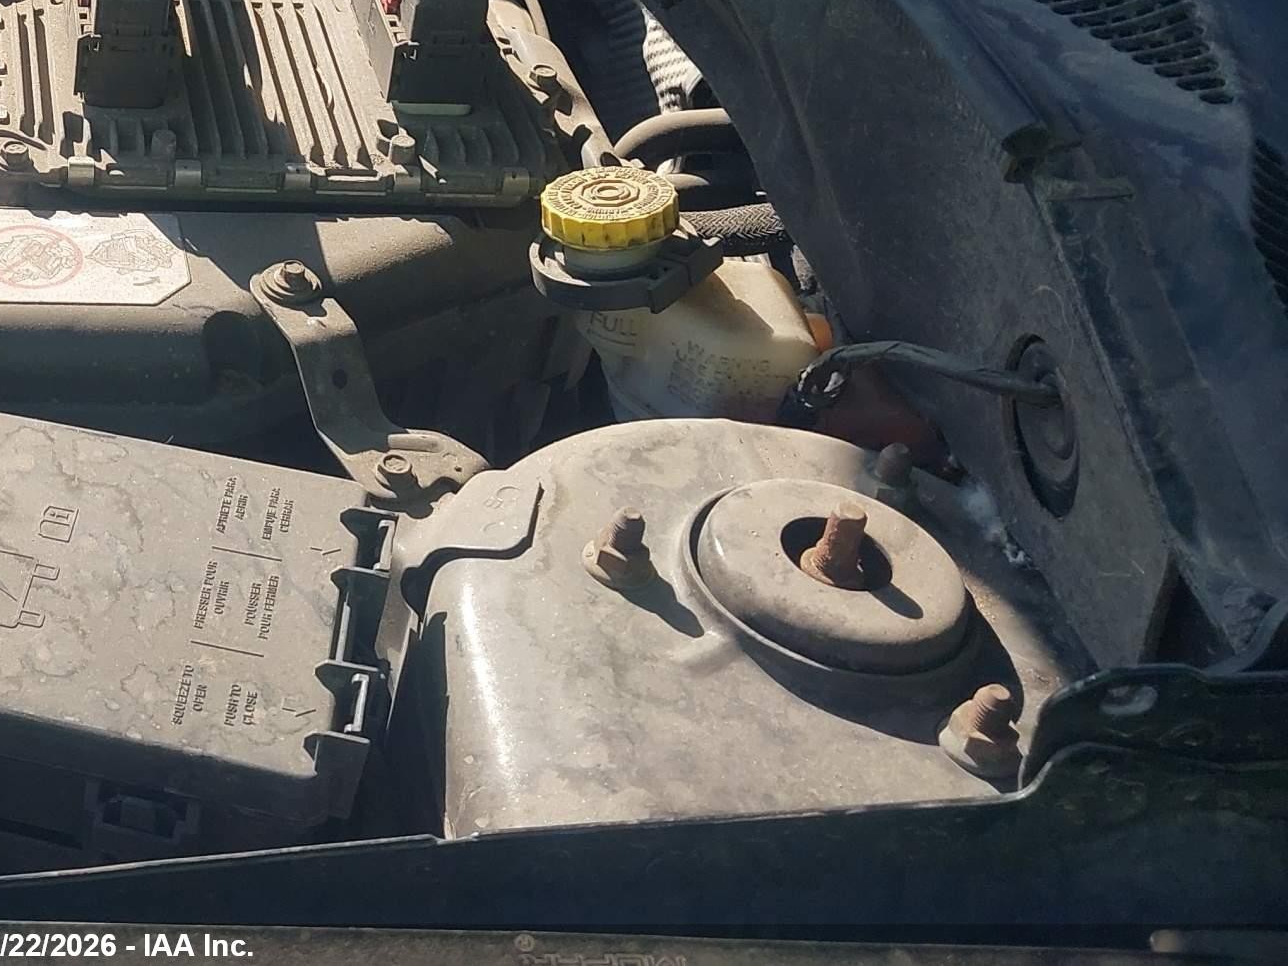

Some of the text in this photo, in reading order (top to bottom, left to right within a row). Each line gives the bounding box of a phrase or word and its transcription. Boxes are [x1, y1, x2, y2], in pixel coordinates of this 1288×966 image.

[589, 309, 638, 336] FULL
[193, 560, 218, 630] PRESSER POUR
[213, 580, 230, 616] OUVRIR
[244, 582, 262, 626] POUSSER
[257, 575, 280, 640] POUR FERMER
[171, 665, 194, 725] SQUEEZE TO
[192, 684, 208, 712] OPEN
[223, 684, 242, 727] PUSH TO
[242, 691, 258, 727] CLOSE
